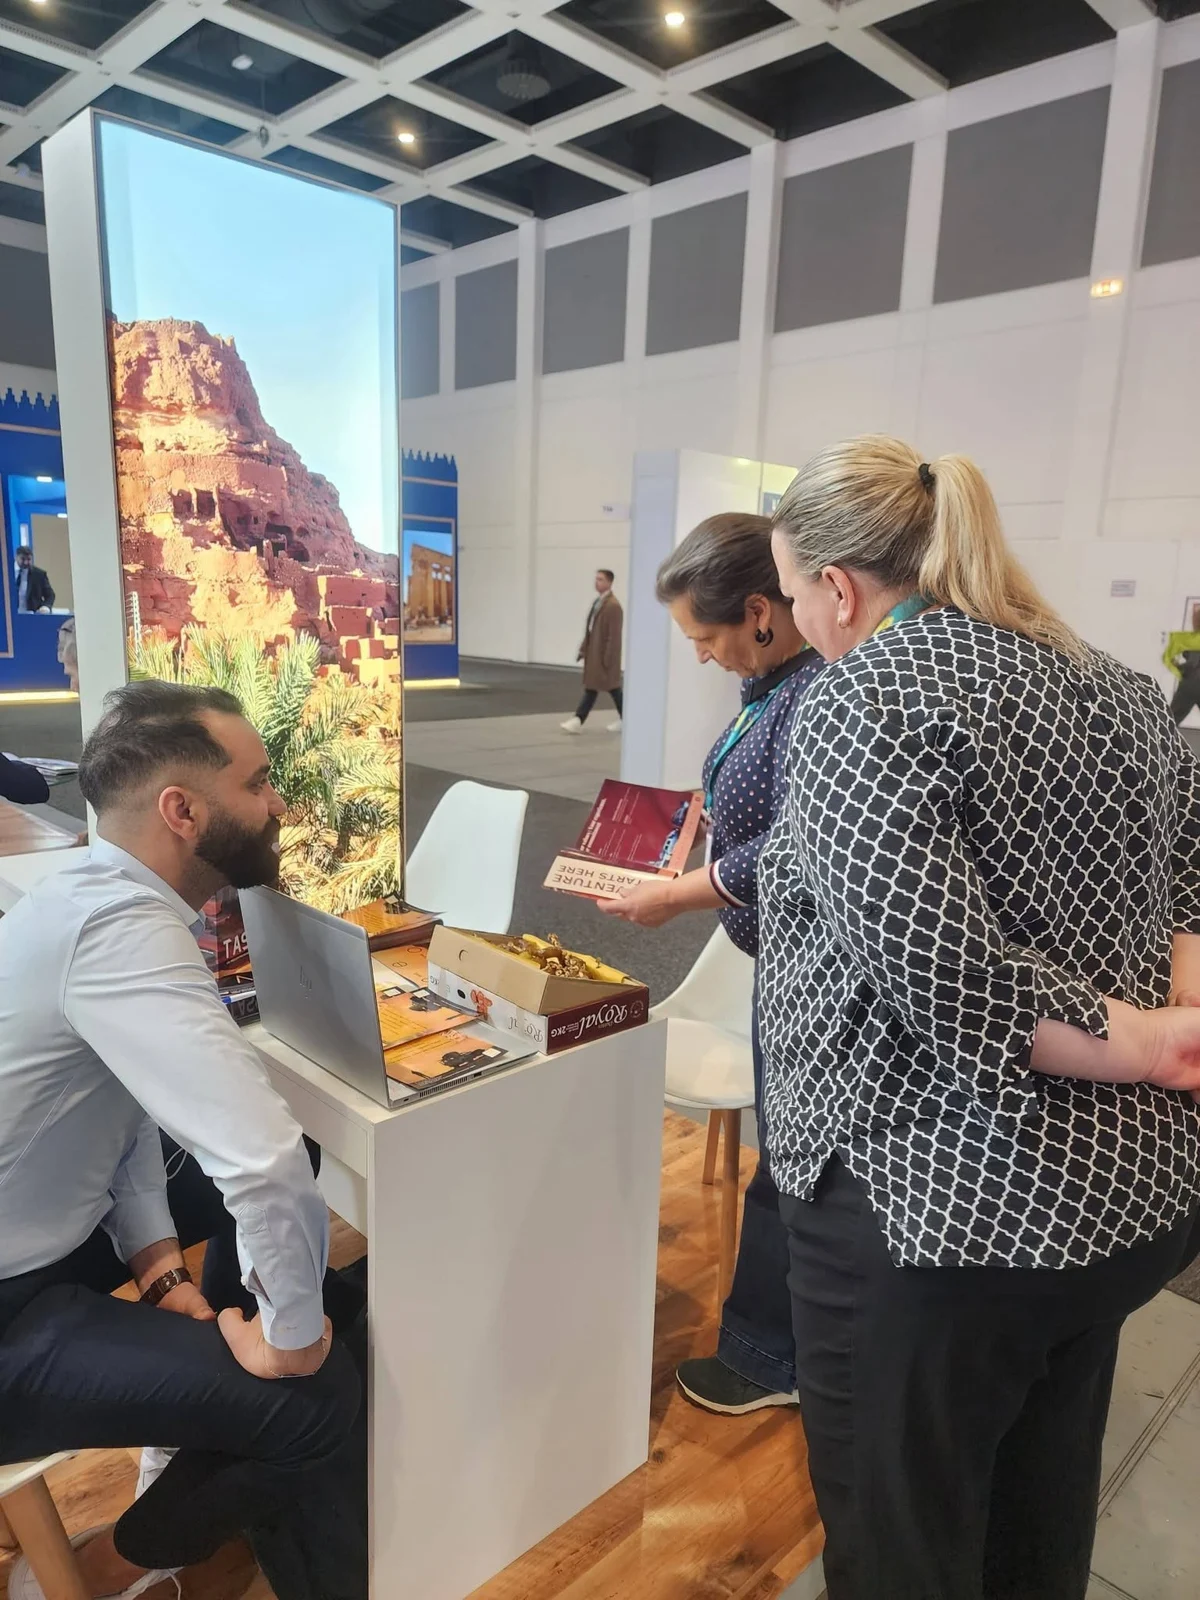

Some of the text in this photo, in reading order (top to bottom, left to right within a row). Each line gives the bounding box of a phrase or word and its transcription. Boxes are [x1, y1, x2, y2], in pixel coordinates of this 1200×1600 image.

[559, 864, 595, 876] HERE
[574, 1003, 628, 1040] Royal
[550, 1025, 566, 1038] 2KG
